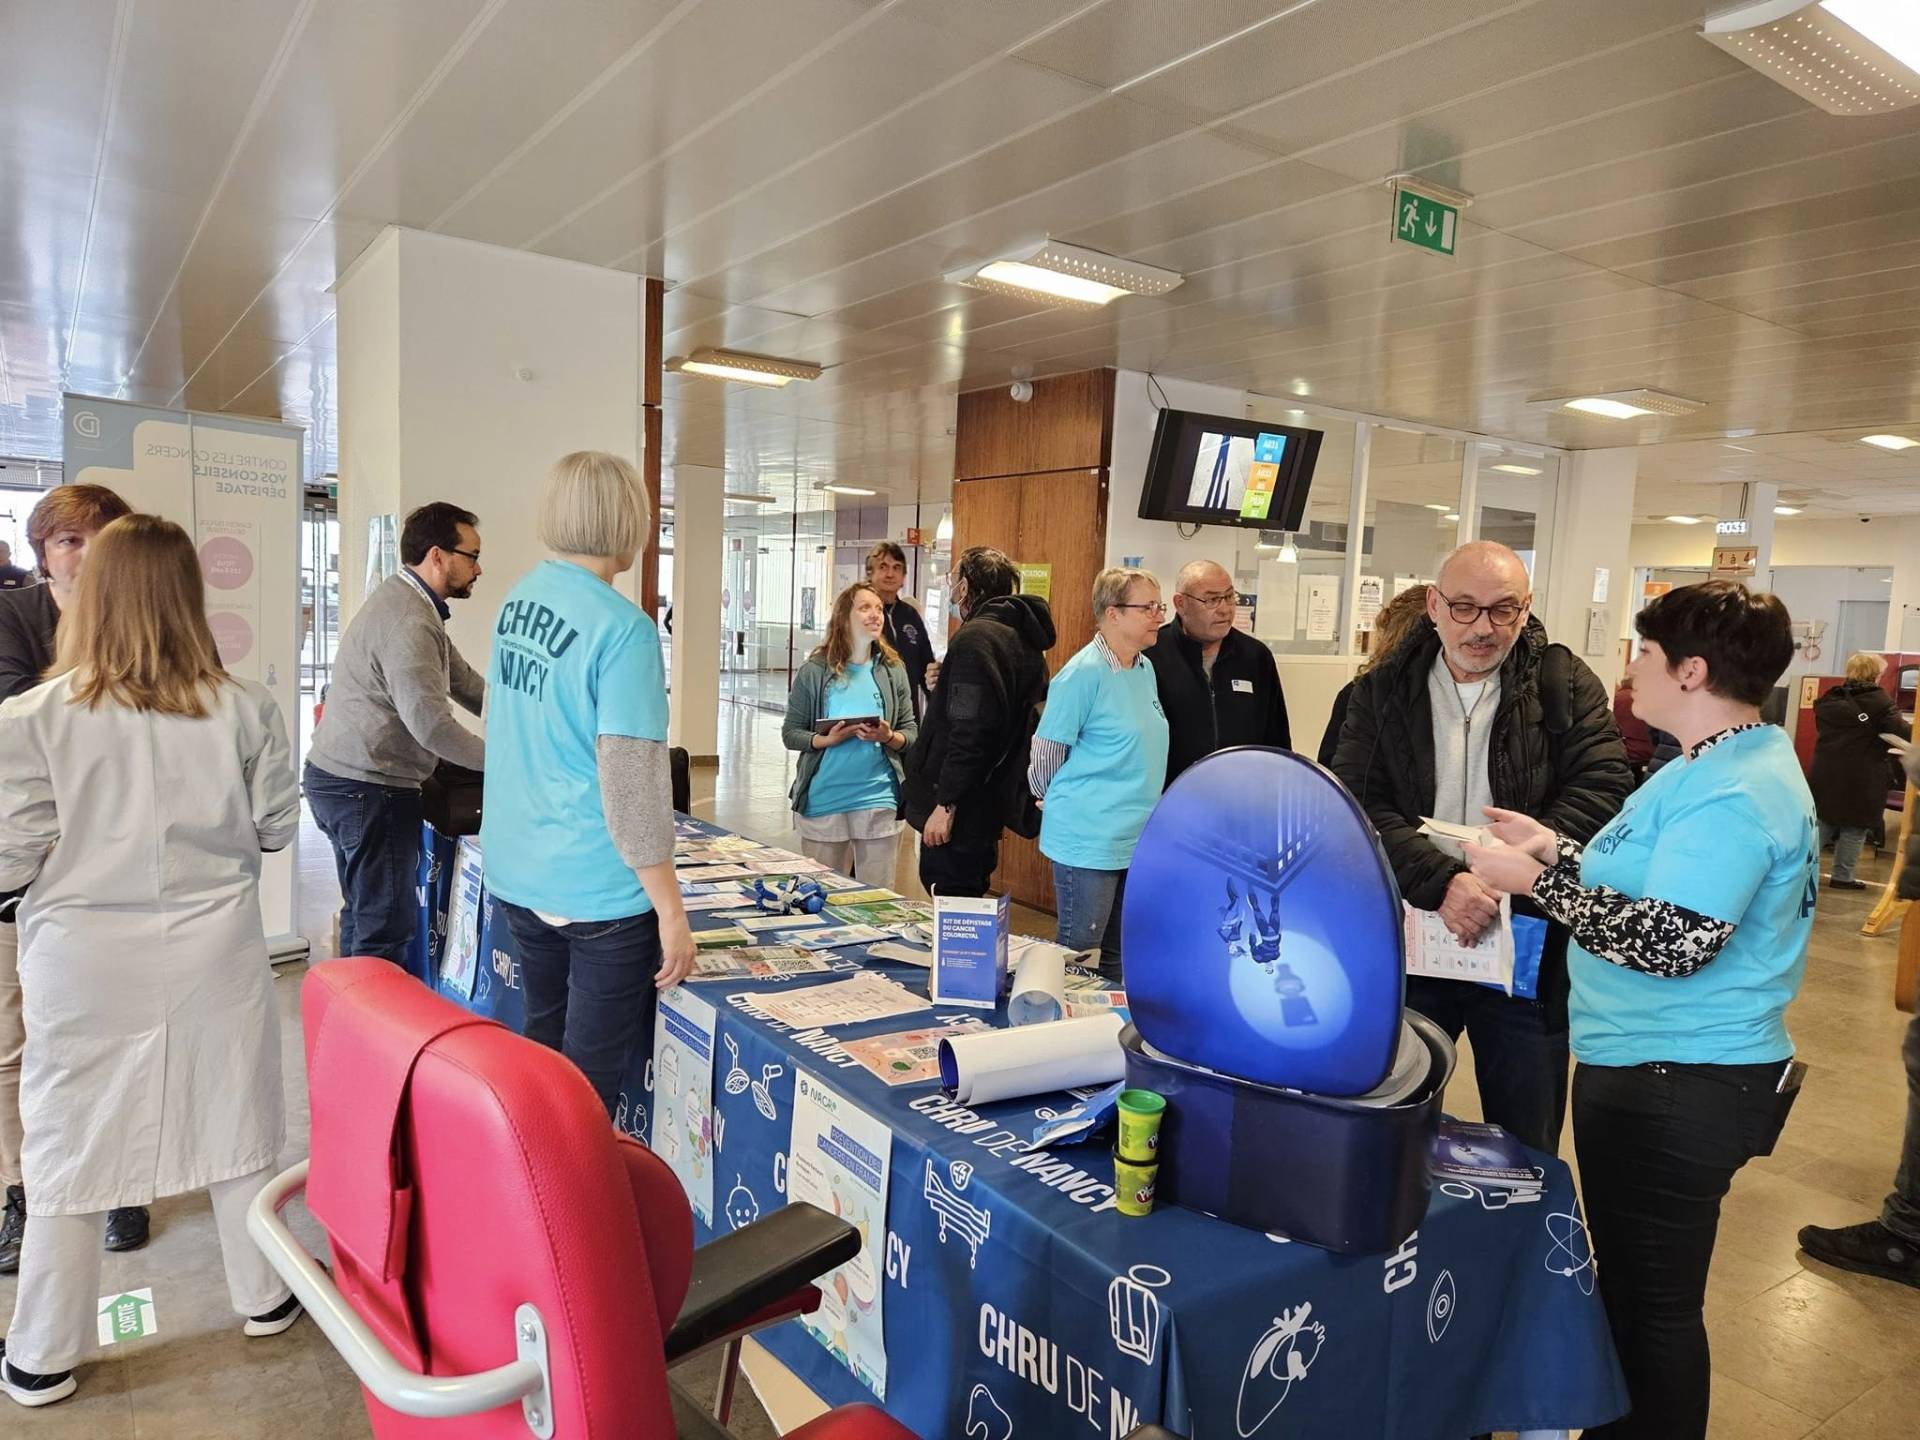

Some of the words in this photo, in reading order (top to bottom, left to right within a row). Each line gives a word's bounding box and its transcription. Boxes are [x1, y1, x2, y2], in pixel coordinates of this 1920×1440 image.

[497, 599, 579, 659] CHRU
[909, 1094, 998, 1135] CHRU
[1009, 1150, 1118, 1213] NANCY
[118, 1302, 138, 1334] SORTIE
[979, 1302, 1058, 1395] CHRU
[1066, 1354, 1104, 1432] DE
